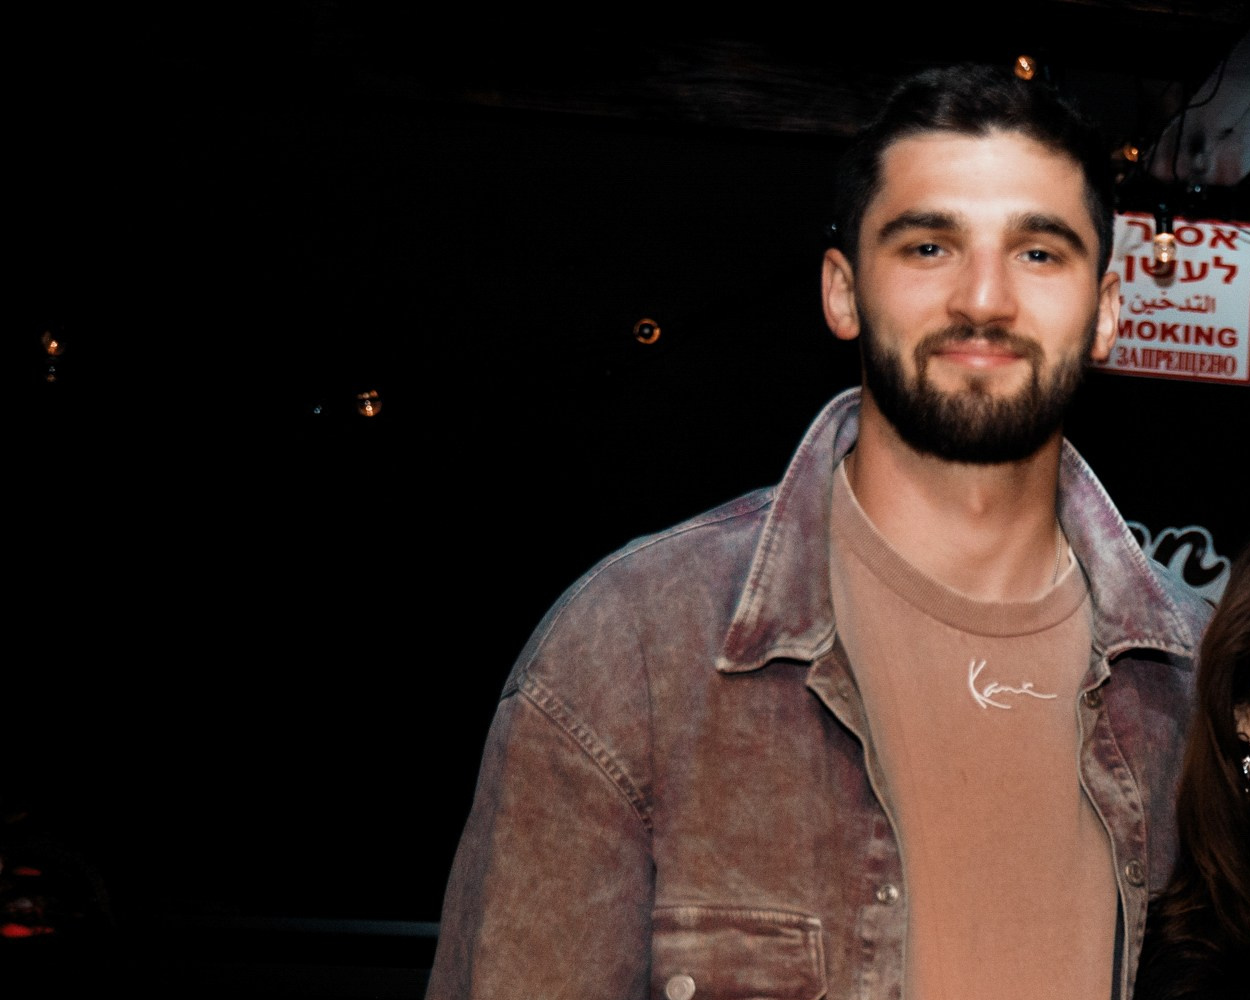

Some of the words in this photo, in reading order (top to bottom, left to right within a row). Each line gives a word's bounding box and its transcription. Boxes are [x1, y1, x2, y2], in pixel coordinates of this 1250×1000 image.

[1127, 220, 1240, 251] אסר
[1124, 255, 1239, 284] לעשן
[1129, 290, 1216, 315] التدخين
[1118, 319, 1238, 348] MOKING
[1115, 346, 1238, 376] ЗАПРЕЩЕНО
